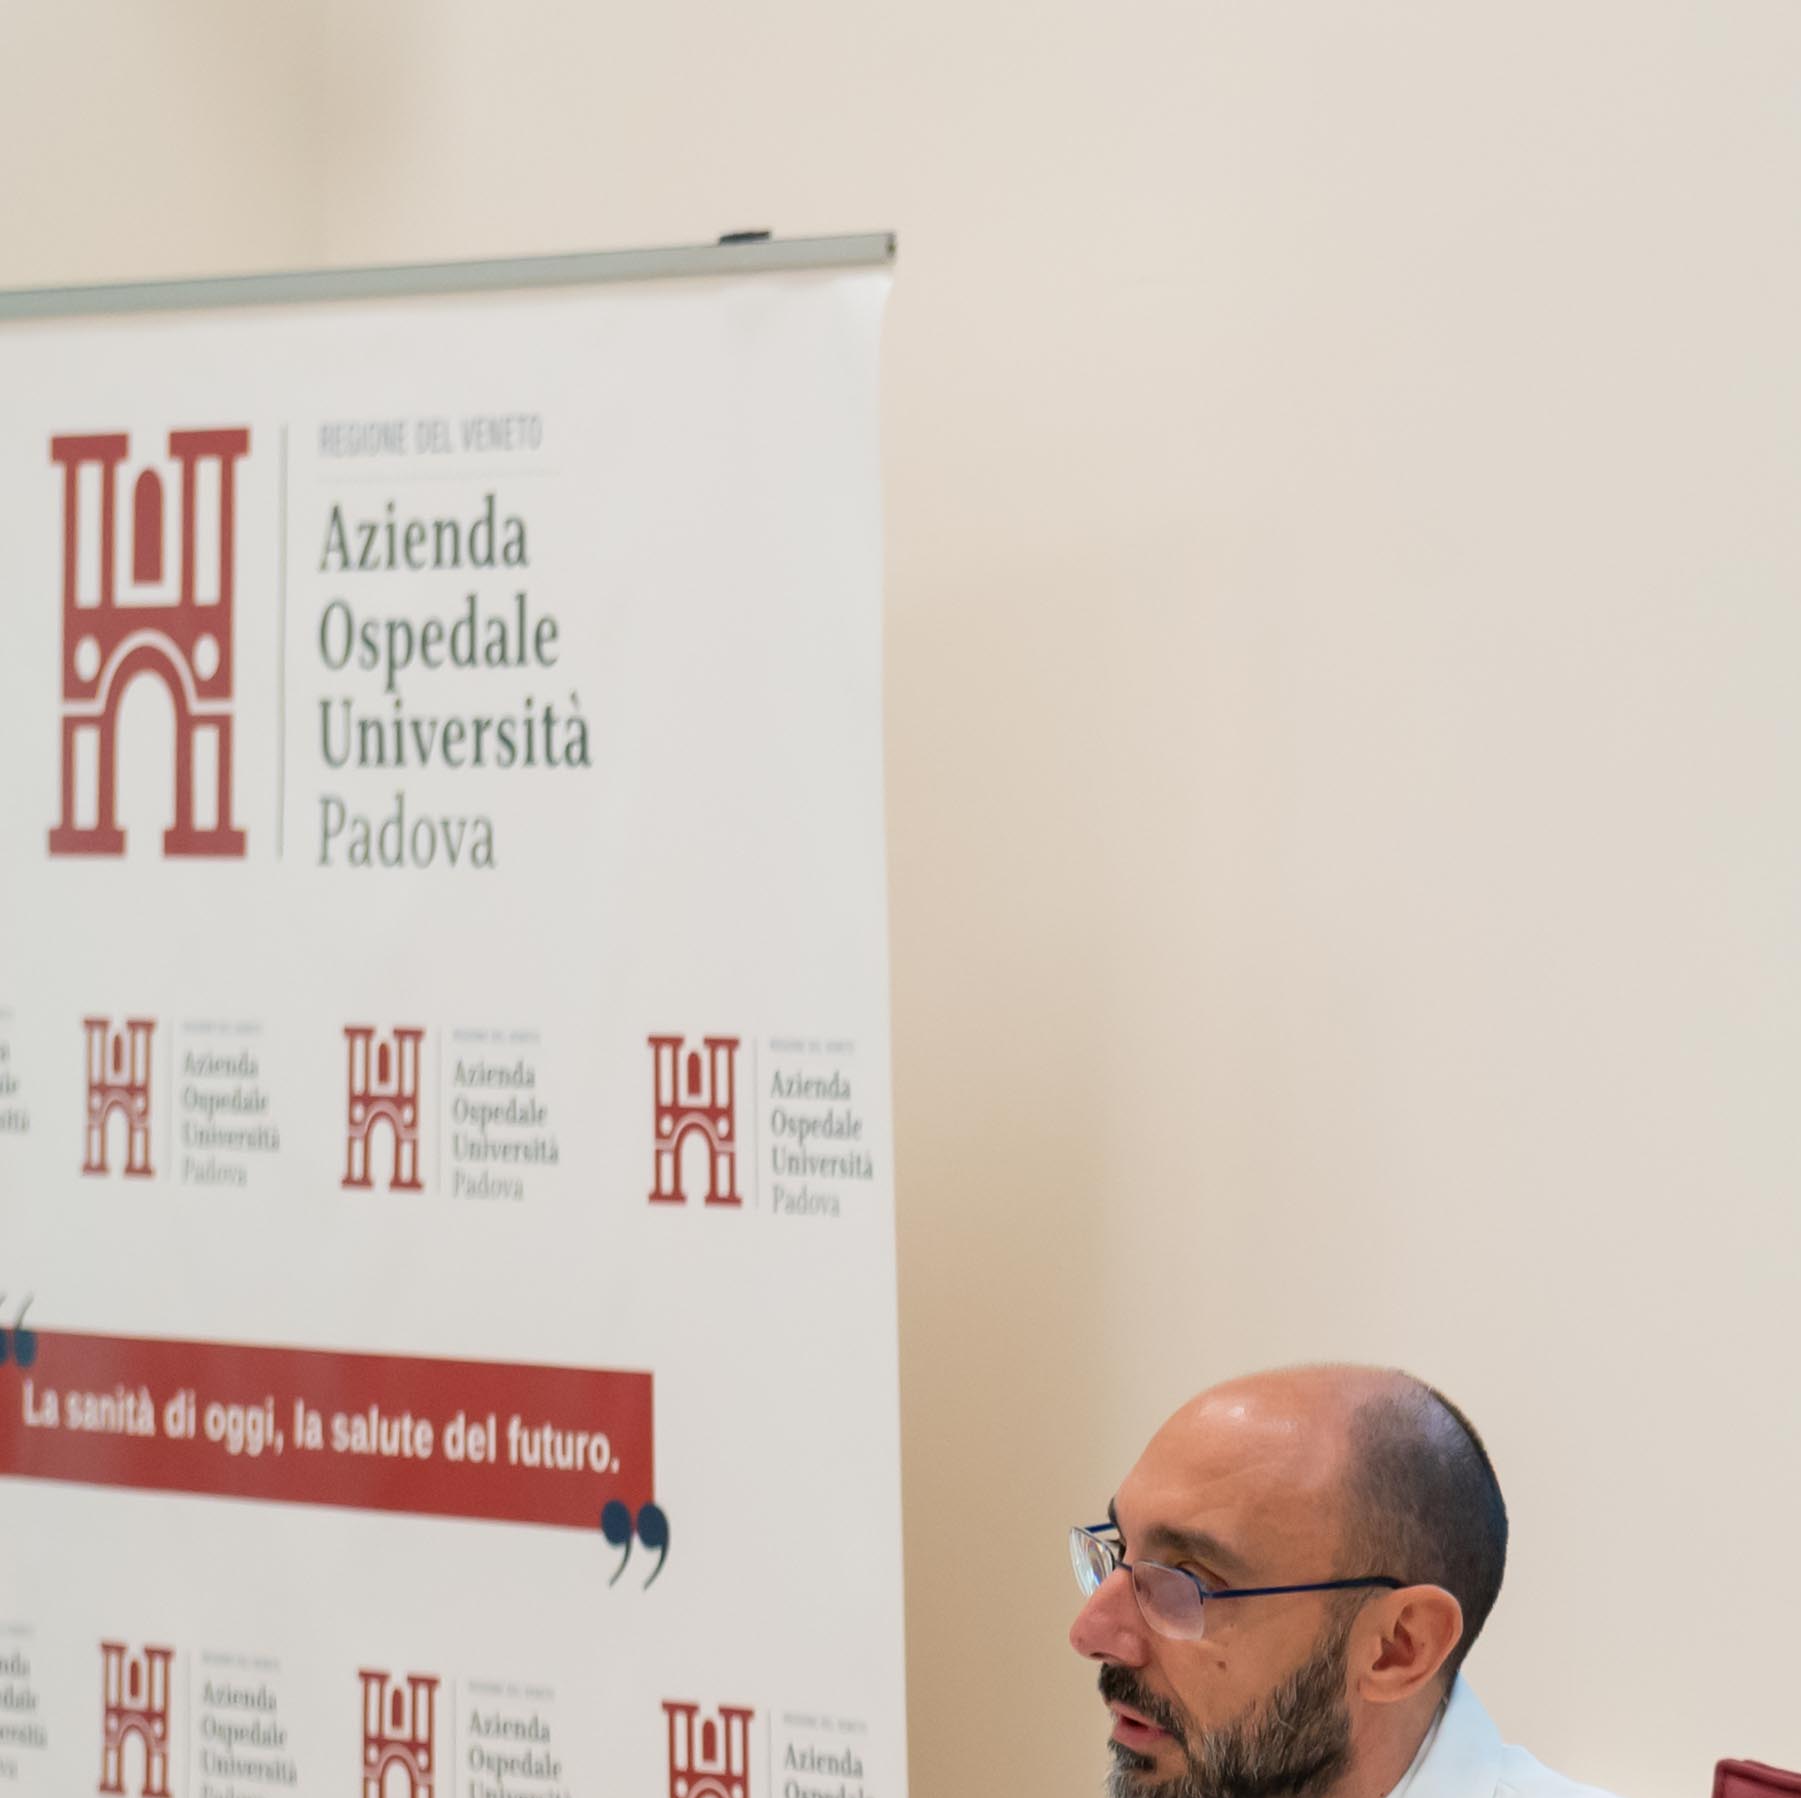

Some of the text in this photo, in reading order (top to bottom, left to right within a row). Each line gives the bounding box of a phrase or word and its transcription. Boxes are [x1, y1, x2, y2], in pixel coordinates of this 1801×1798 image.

[319, 413, 544, 458] REGIONE DEL VENETO
[319, 492, 529, 573] Azienda
[318, 592, 560, 694] Ospedale
[318, 689, 593, 770] Università
[317, 790, 496, 870] Padova
[770, 1069, 851, 1098] Azienda
[770, 1108, 863, 1146] Ospedale
[771, 1146, 873, 1180] Università
[772, 1184, 840, 1217] Padova
[23, 1381, 621, 1474] La sanità di oggi, la salute del futuro.
[785, 1743, 864, 1778] Azienda
